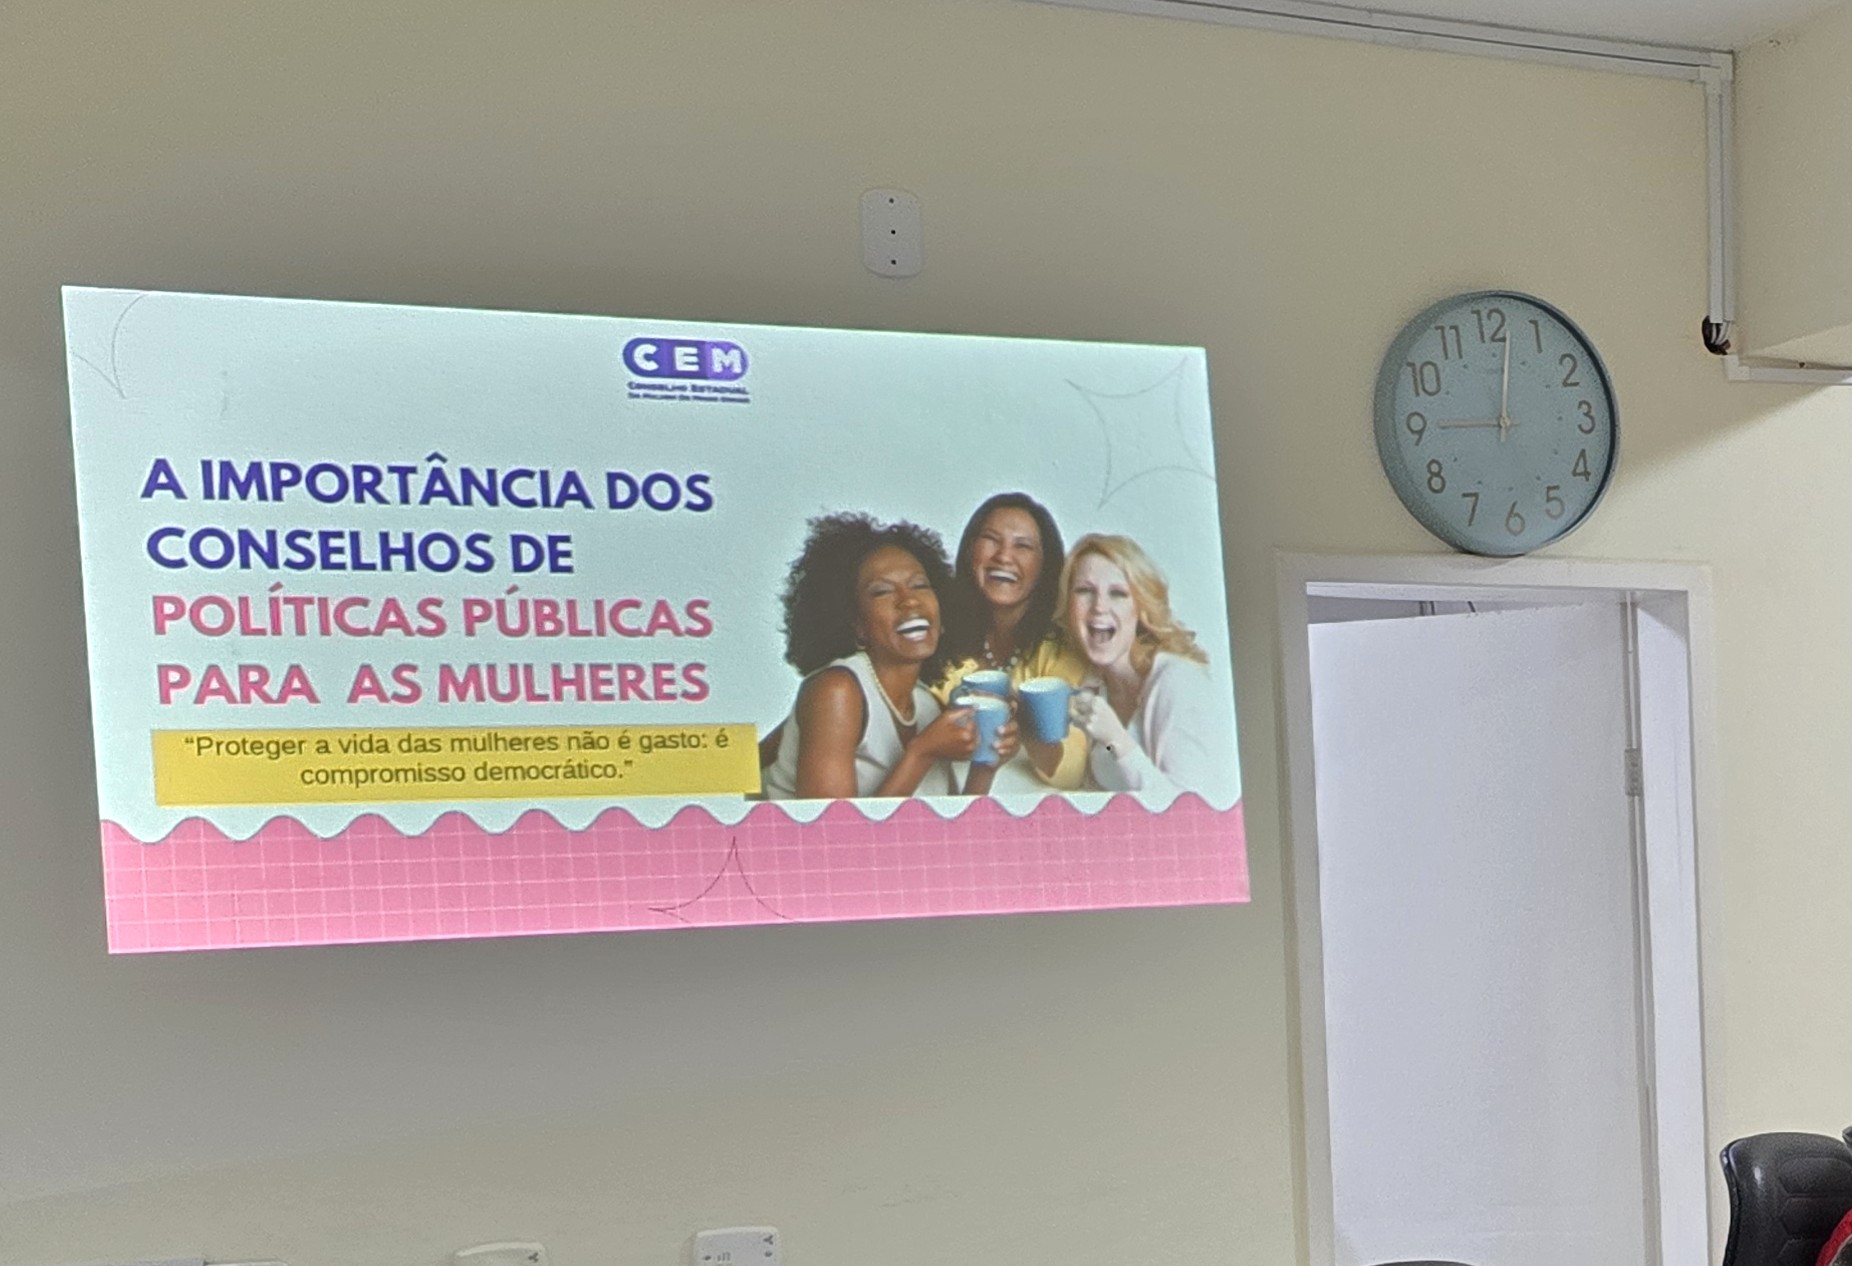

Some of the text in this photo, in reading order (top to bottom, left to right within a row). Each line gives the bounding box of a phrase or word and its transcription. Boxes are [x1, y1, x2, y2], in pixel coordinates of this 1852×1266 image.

[1435, 325, 1464, 360] 11
[1471, 308, 1507, 343] 12
[1528, 319, 1543, 354] 1
[632, 343, 743, 374] CEM
[1558, 353, 1580, 388] 2
[1407, 360, 1441, 397] 10
[1406, 411, 1427, 446] 9
[1577, 400, 1596, 434] 3
[140, 452, 714, 513] A IMPORTÂNCIA DOS
[1426, 458, 1446, 494] 8
[1571, 448, 1591, 482] 4
[1461, 492, 1480, 526] 7
[1505, 501, 1526, 536] 6
[1545, 485, 1565, 519] 5
[147, 526, 574, 574] CONSELHOS DE
[152, 581, 713, 638] POLÍTICAS PÚBLICAS
[157, 662, 710, 705] PARA AS MULHERES
[315, 738, 331, 754] a
[338, 734, 391, 754] vida
[398, 733, 442, 753] das
[450, 732, 559, 752] mulheres
[567, 731, 610, 749] não
[618, 730, 632, 749] é
[639, 732, 708, 753] gasto:
[715, 728, 729, 748] é
[300, 763, 466, 788] compromisso
